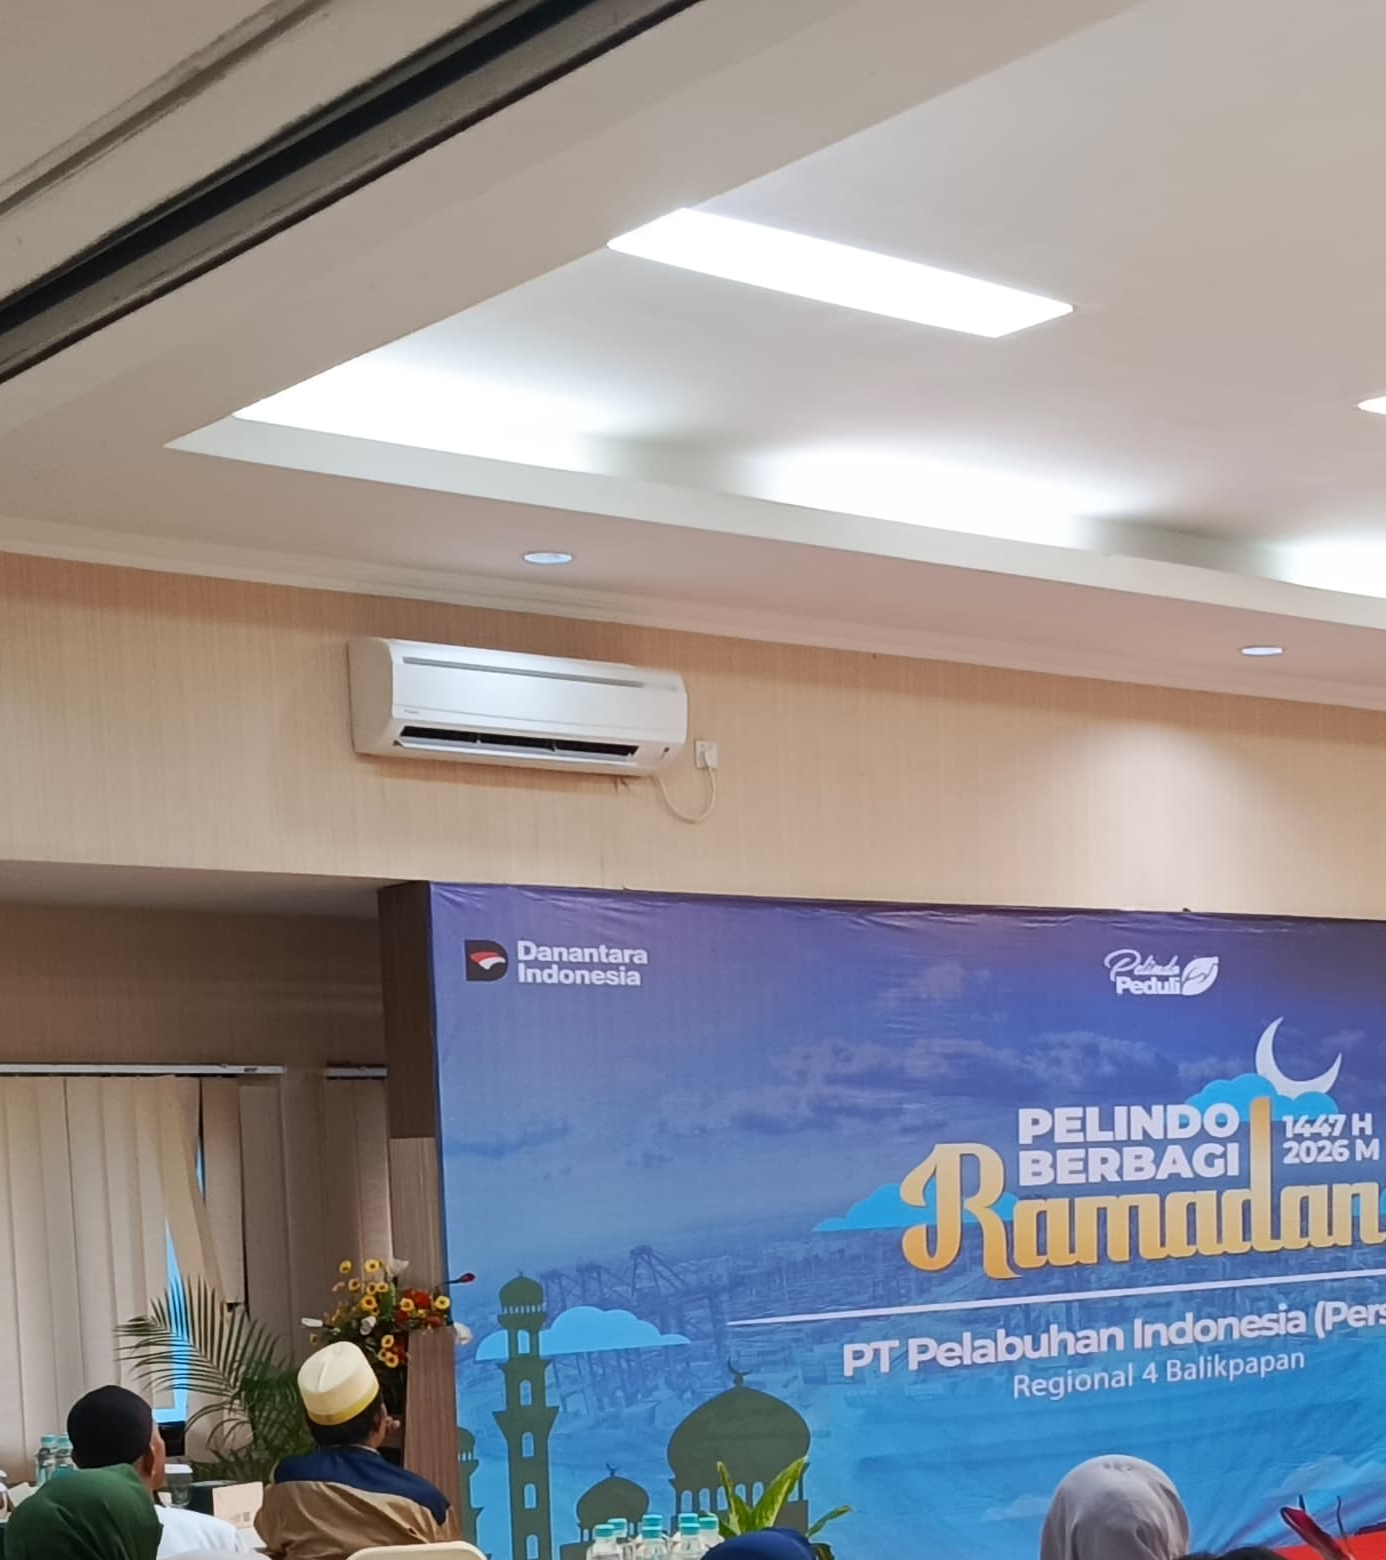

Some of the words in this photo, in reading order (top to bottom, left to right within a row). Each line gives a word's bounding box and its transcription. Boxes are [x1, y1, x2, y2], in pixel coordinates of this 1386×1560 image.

[516, 940, 648, 964] Danantara
[517, 963, 641, 986] Indonesia
[1116, 976, 1181, 995] Peduli
[1018, 1103, 1240, 1145] PELINDO
[1283, 1113, 1346, 1138] 1447
[1352, 1112, 1373, 1136] H
[1018, 1142, 1240, 1186] BERBAGI
[1283, 1139, 1349, 1165] 2026
[1355, 1138, 1380, 1161] M
[842, 1339, 900, 1377] PT
[907, 1323, 1126, 1371] Pelabuhan
[1132, 1303, 1308, 1348] Indonesia
[1011, 1362, 1135, 1400] Regional
[1141, 1366, 1159, 1386] 4
[1165, 1351, 1306, 1383] Balikpapan
